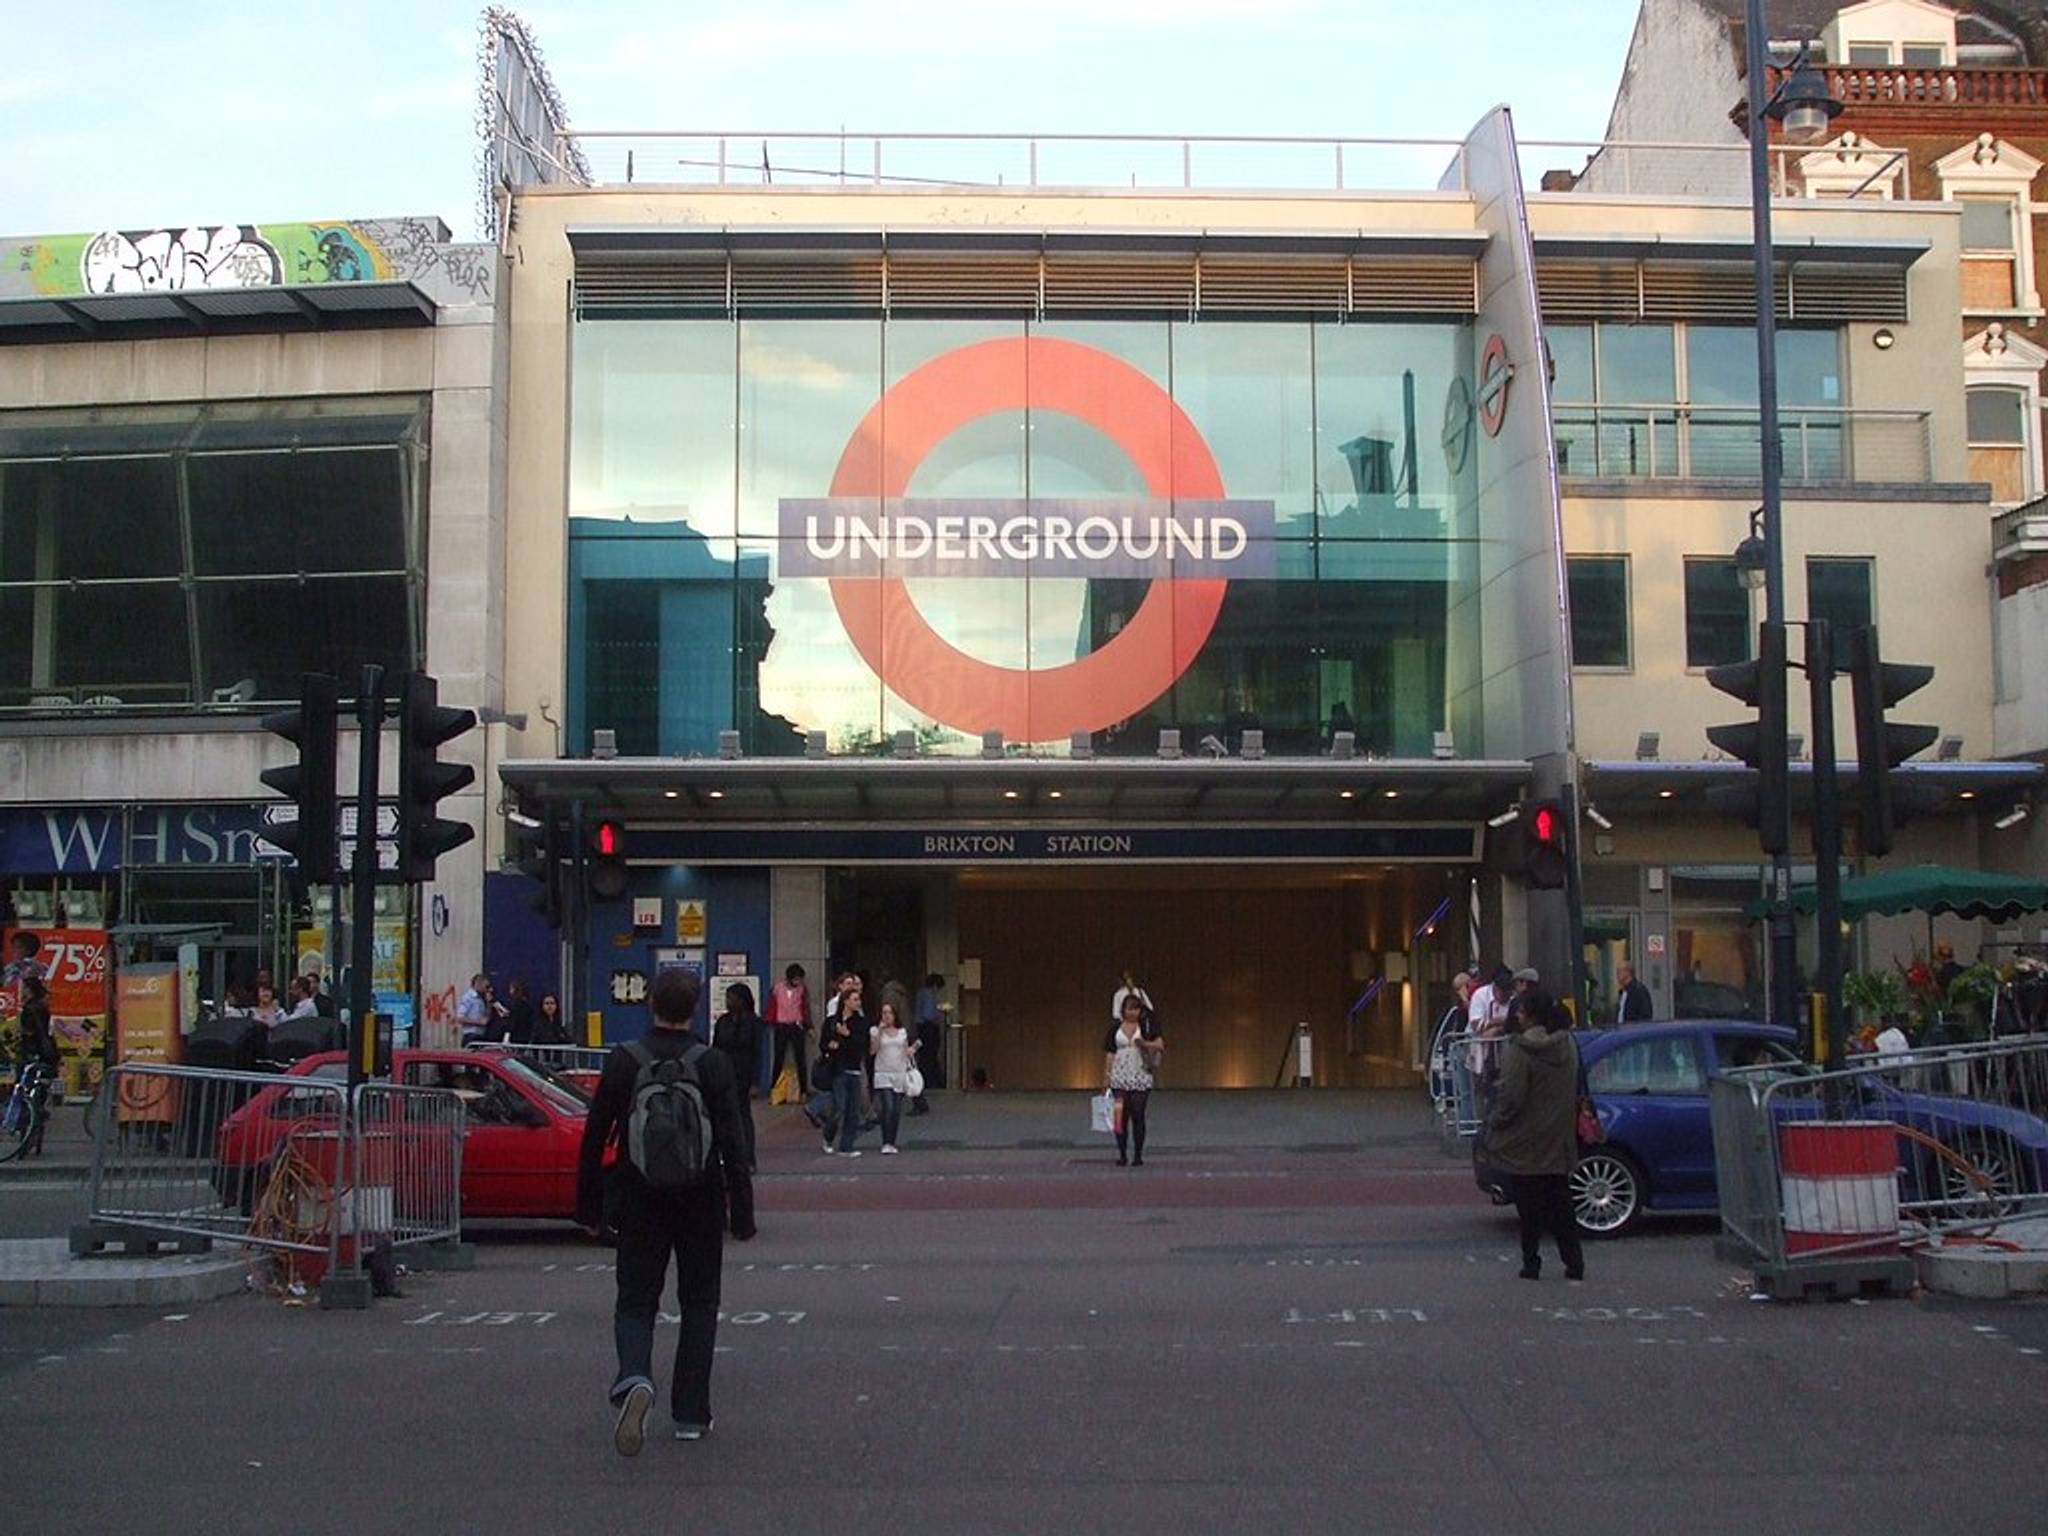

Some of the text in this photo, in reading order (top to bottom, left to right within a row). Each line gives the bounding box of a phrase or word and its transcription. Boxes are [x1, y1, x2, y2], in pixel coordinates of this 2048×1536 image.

[806, 515, 1247, 560] UNDERGROUND
[924, 835, 1132, 852] BRIXTON STATION
[43, 944, 105, 982] 75%
[655, 1311, 807, 1326] LOK
